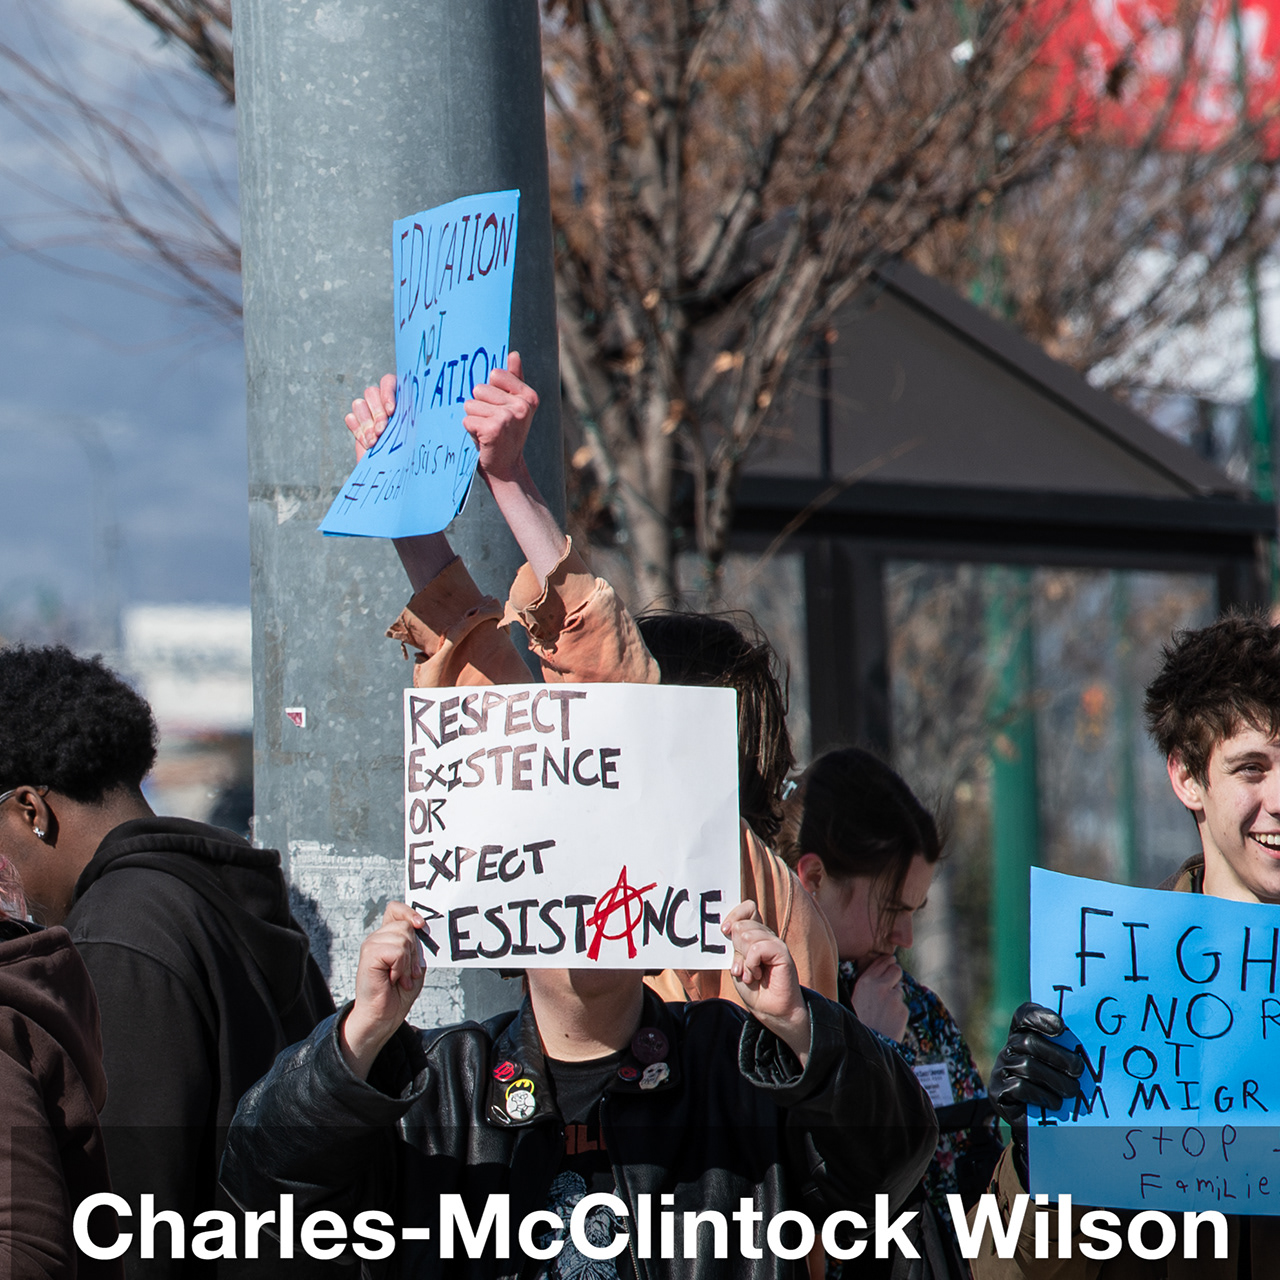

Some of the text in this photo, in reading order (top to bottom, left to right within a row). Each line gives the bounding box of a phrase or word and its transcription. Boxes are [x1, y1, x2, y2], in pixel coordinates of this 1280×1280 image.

[399, 211, 515, 333] EDUCATION
[416, 310, 447, 375] NOT
[409, 689, 587, 749] RESPECT
[409, 798, 447, 834] OR
[411, 865, 727, 961] RESISTANCE
